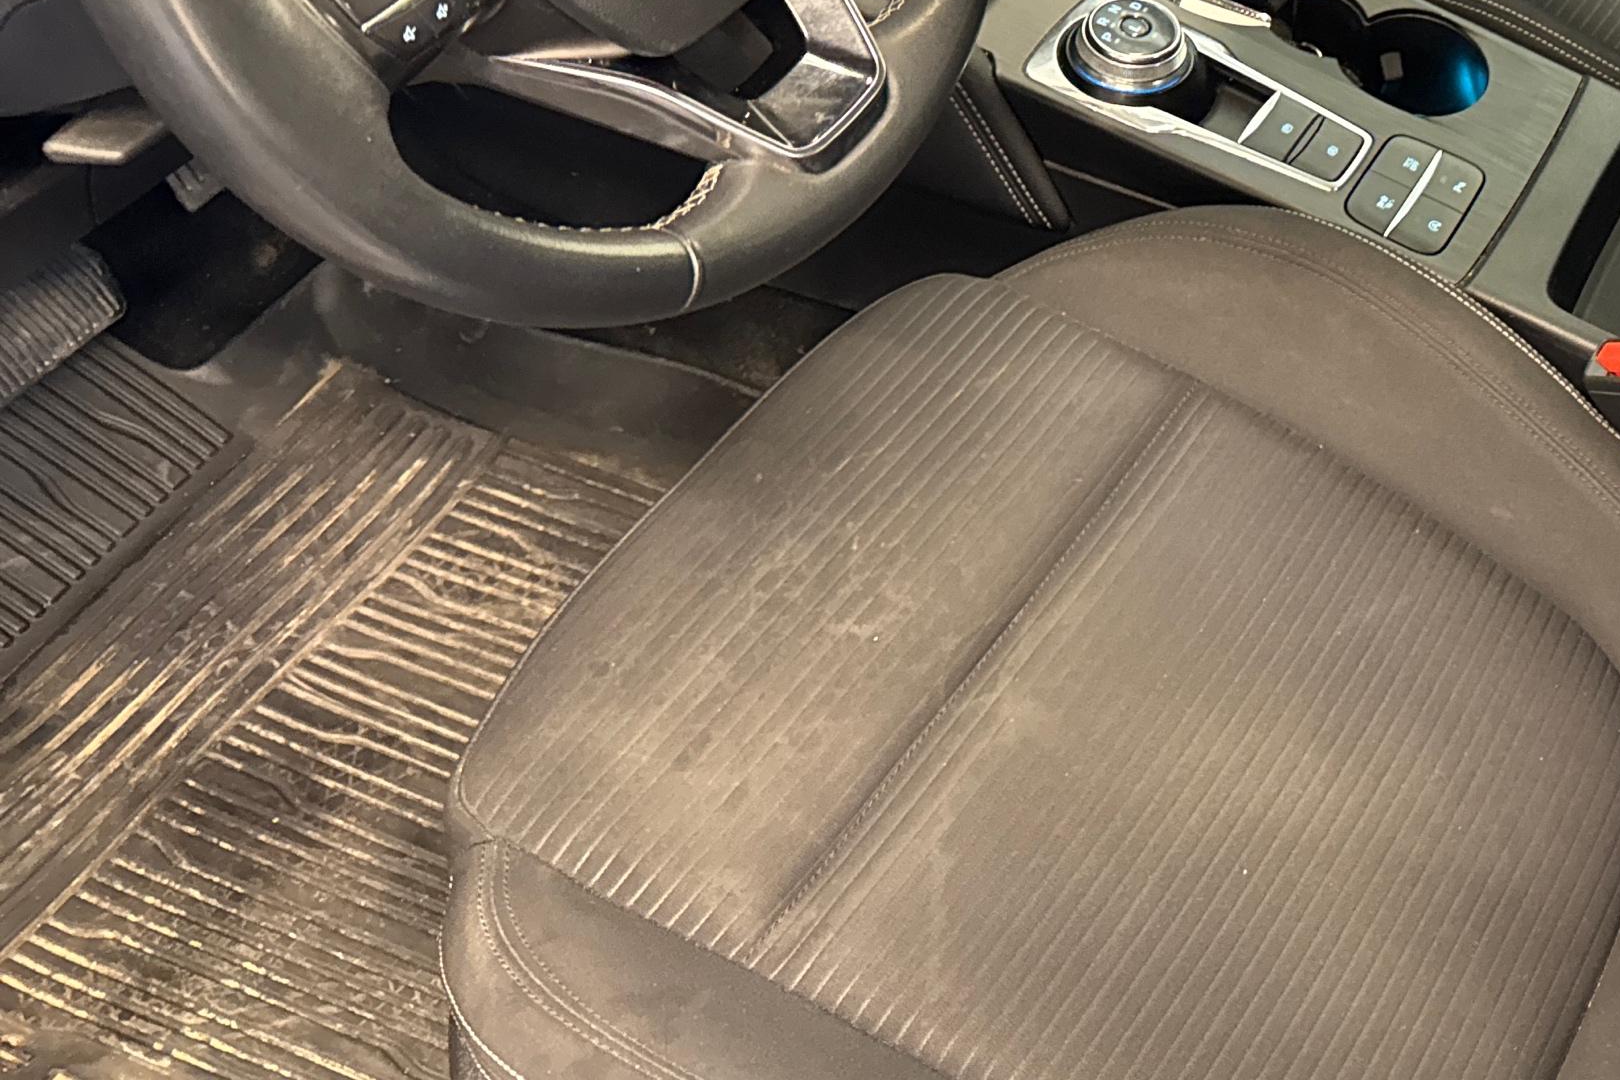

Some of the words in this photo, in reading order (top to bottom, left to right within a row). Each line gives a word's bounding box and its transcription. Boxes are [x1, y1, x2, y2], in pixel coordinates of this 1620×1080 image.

[1107, 4, 1122, 14] N
[1129, 1, 1142, 11] D
[1096, 16, 1110, 27] R
[1101, 31, 1112, 42] P
